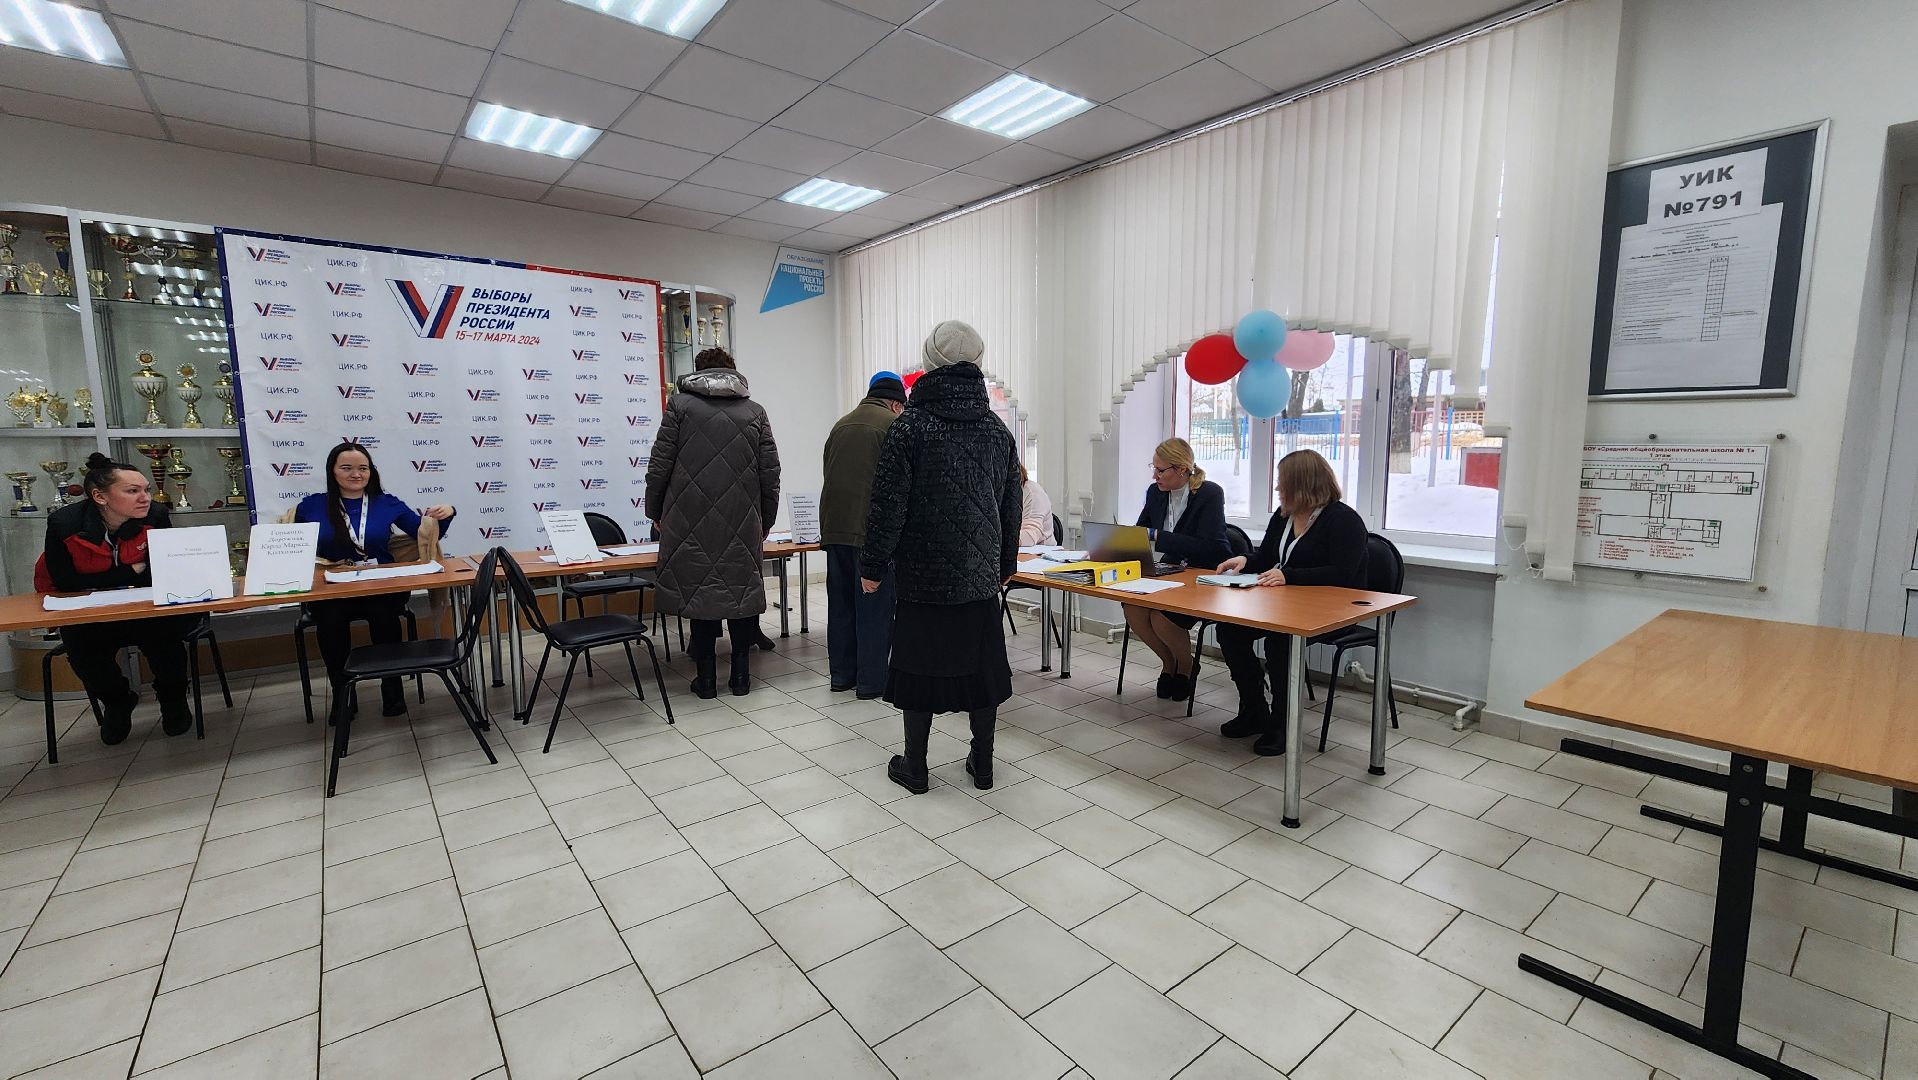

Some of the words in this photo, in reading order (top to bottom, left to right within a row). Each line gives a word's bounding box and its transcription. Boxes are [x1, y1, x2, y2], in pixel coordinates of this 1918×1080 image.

[1679, 165, 1734, 189] УИК
[1664, 191, 1742, 218] №791
[327, 259, 357, 267] ЦИК.РФ
[780, 265, 823, 277] НАЦИОНАЛЬНЫЕ
[255, 279, 287, 287] ЦИК.РФ
[800, 275, 823, 285] ПРОЕКТЫ
[804, 284, 823, 292] РОССИИ
[472, 288, 532, 303] ВЫБОРЫ
[466, 302, 550, 319] ПРЕЗИДЕНТА
[460, 317, 515, 330] РОССИИ
[485, 333, 516, 343] МАРТА
[518, 336, 540, 345] 2024
